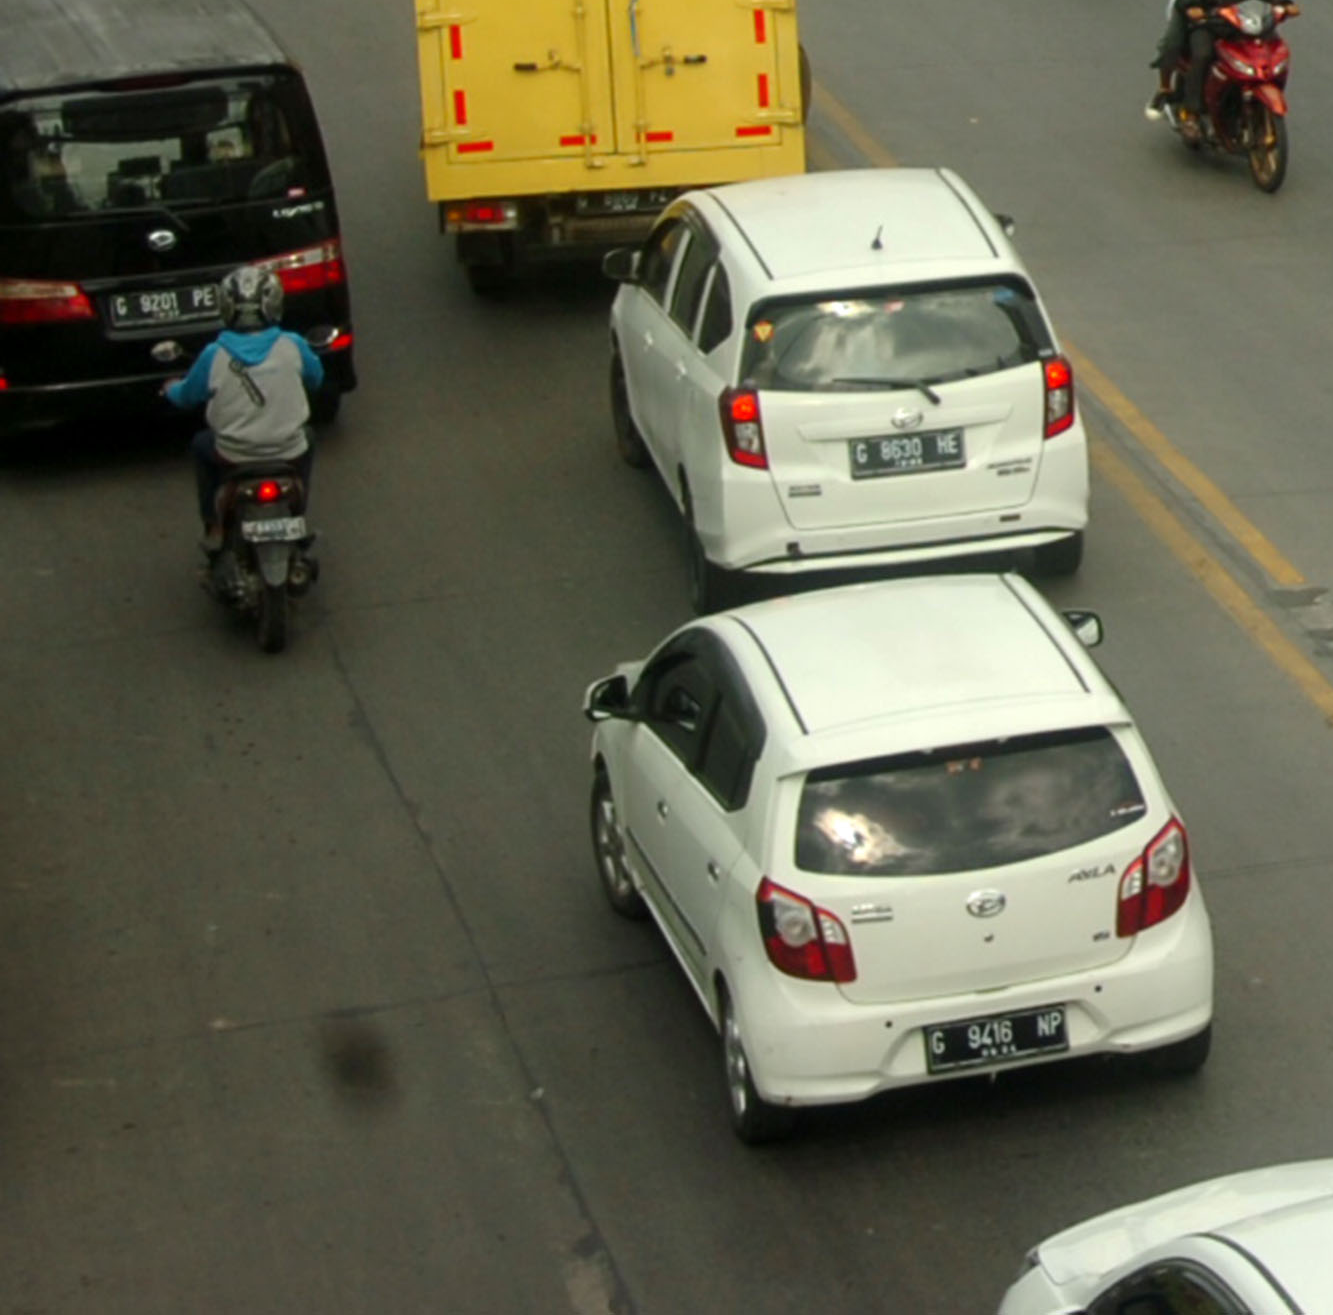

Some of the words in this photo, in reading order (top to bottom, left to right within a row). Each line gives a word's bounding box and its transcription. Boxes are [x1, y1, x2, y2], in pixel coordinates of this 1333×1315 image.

[116, 298, 127, 316] G
[139, 291, 178, 313] 9201
[192, 286, 215, 306] PE
[855, 443, 868, 464] G
[880, 438, 922, 460] 8630
[932, 1031, 946, 1054] G
[967, 1020, 1013, 1050] 9416
[1036, 1011, 1062, 1037] NP
